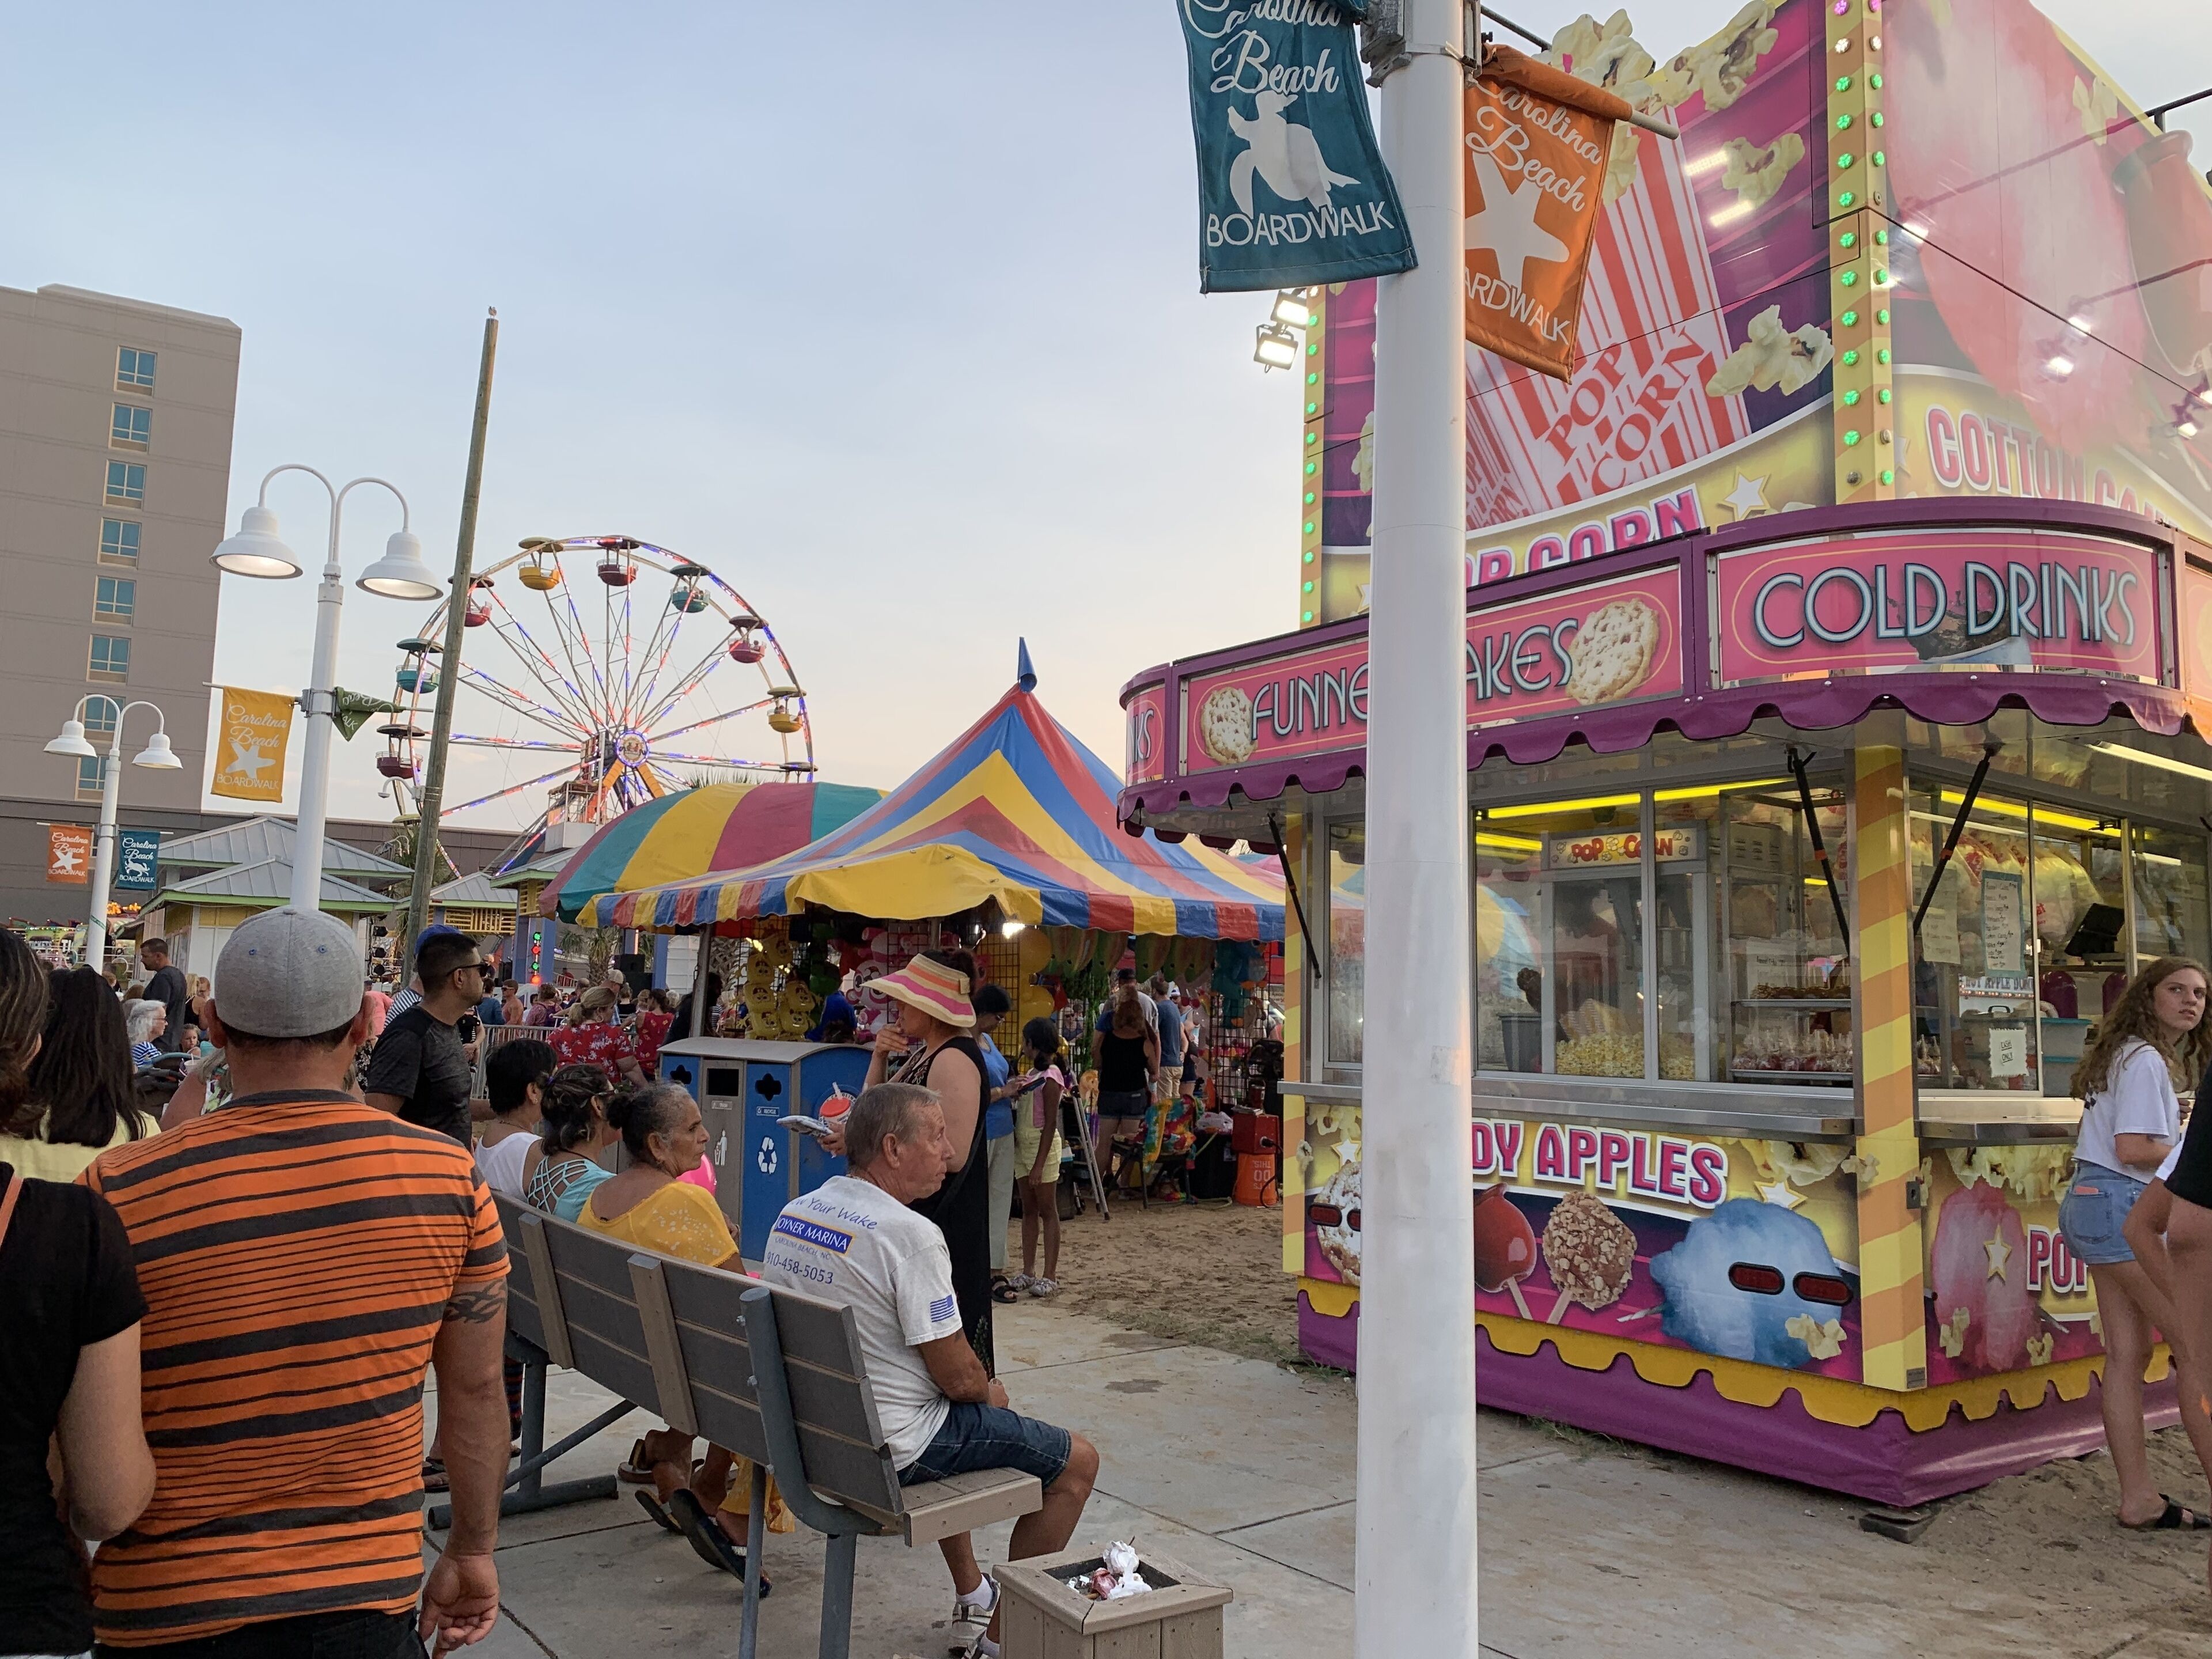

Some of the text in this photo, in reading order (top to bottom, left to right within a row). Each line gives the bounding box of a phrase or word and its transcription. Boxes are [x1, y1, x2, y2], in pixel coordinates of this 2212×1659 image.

[1211, 30, 1339, 93] Beach
[1473, 79, 1601, 165] arolina
[1465, 105, 1586, 213] Beach
[1207, 201, 1395, 247] BOARDWALK
[1545, 342, 1627, 467] POP
[1591, 325, 1705, 495] CORN
[1926, 406, 2087, 502] COTTON
[1754, 560, 2138, 647] COLD DRINKS
[226, 703, 287, 729] Carolina
[228, 726, 279, 748] Beach
[216, 773, 279, 790] BOARDWALK
[52, 832, 89, 844] Carolina
[53, 842, 85, 854] Beach
[122, 837, 157, 850] Carolina
[1571, 837, 1604, 863] POP
[124, 848, 154, 860] Beach
[48, 868, 86, 877] BOARDWALK
[120, 874, 155, 883] BOARDWALK
[2000, 1039, 2012, 1049] CASH
[2001, 1052, 2013, 1062] ONLY
[1535, 1124, 1726, 1207] APPLES
[808, 1197, 836, 1214] Your
[837, 1207, 878, 1230] Wake
[804, 1226, 847, 1251] MARINA
[766, 1251, 834, 1285] 910-458-5053
[820, 1251, 831, 1260] NC
